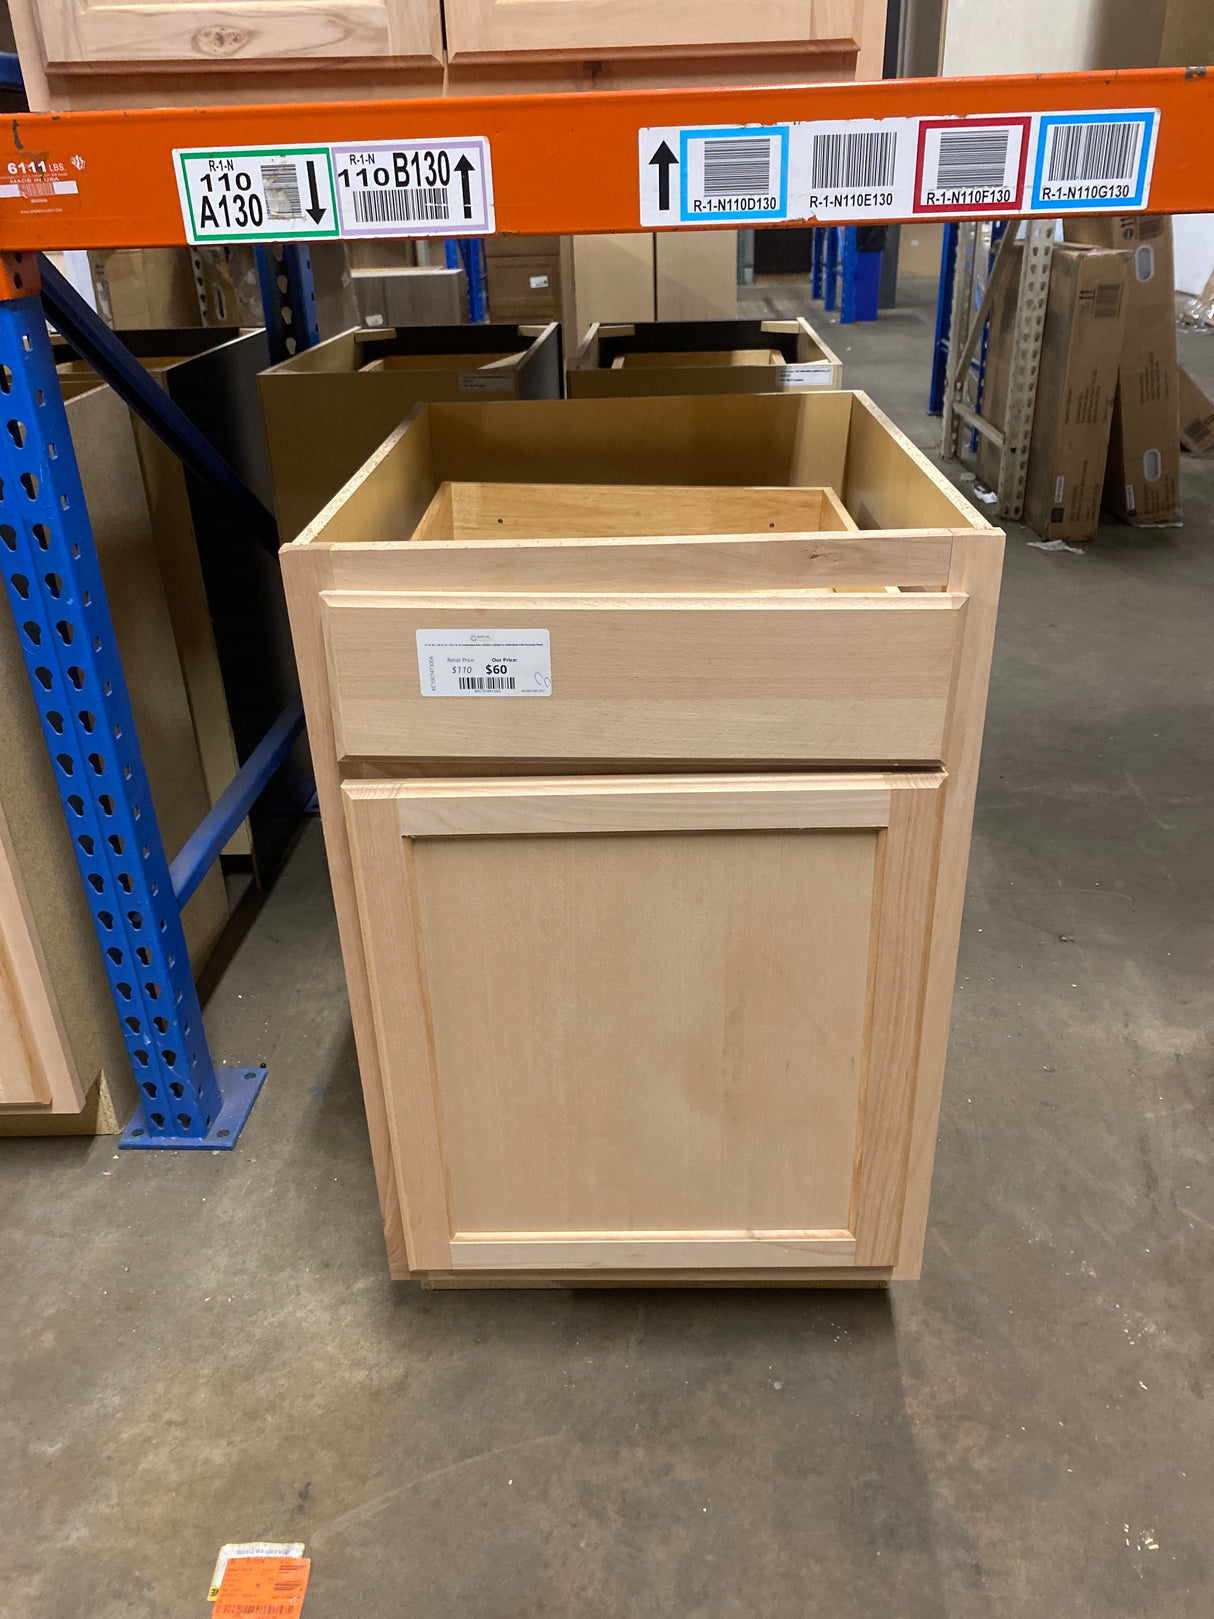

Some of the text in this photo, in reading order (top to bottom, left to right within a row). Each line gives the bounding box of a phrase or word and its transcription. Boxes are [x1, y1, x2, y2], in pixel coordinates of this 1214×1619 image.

[7, 160, 47, 174] 6111
[208, 159, 234, 172] R-1-N
[349, 153, 375, 165] R-1-N
[200, 172, 251, 192] 110
[809, 192, 893, 208] R-1-N110E130
[926, 189, 1011, 205] R-1-N110F130
[1042, 184, 1130, 200] R-1-N110G130
[200, 193, 263, 228] A130
[693, 196, 777, 212] R-1-N110D130
[452, 666, 472, 674] $110
[485, 664, 508, 675] $60
